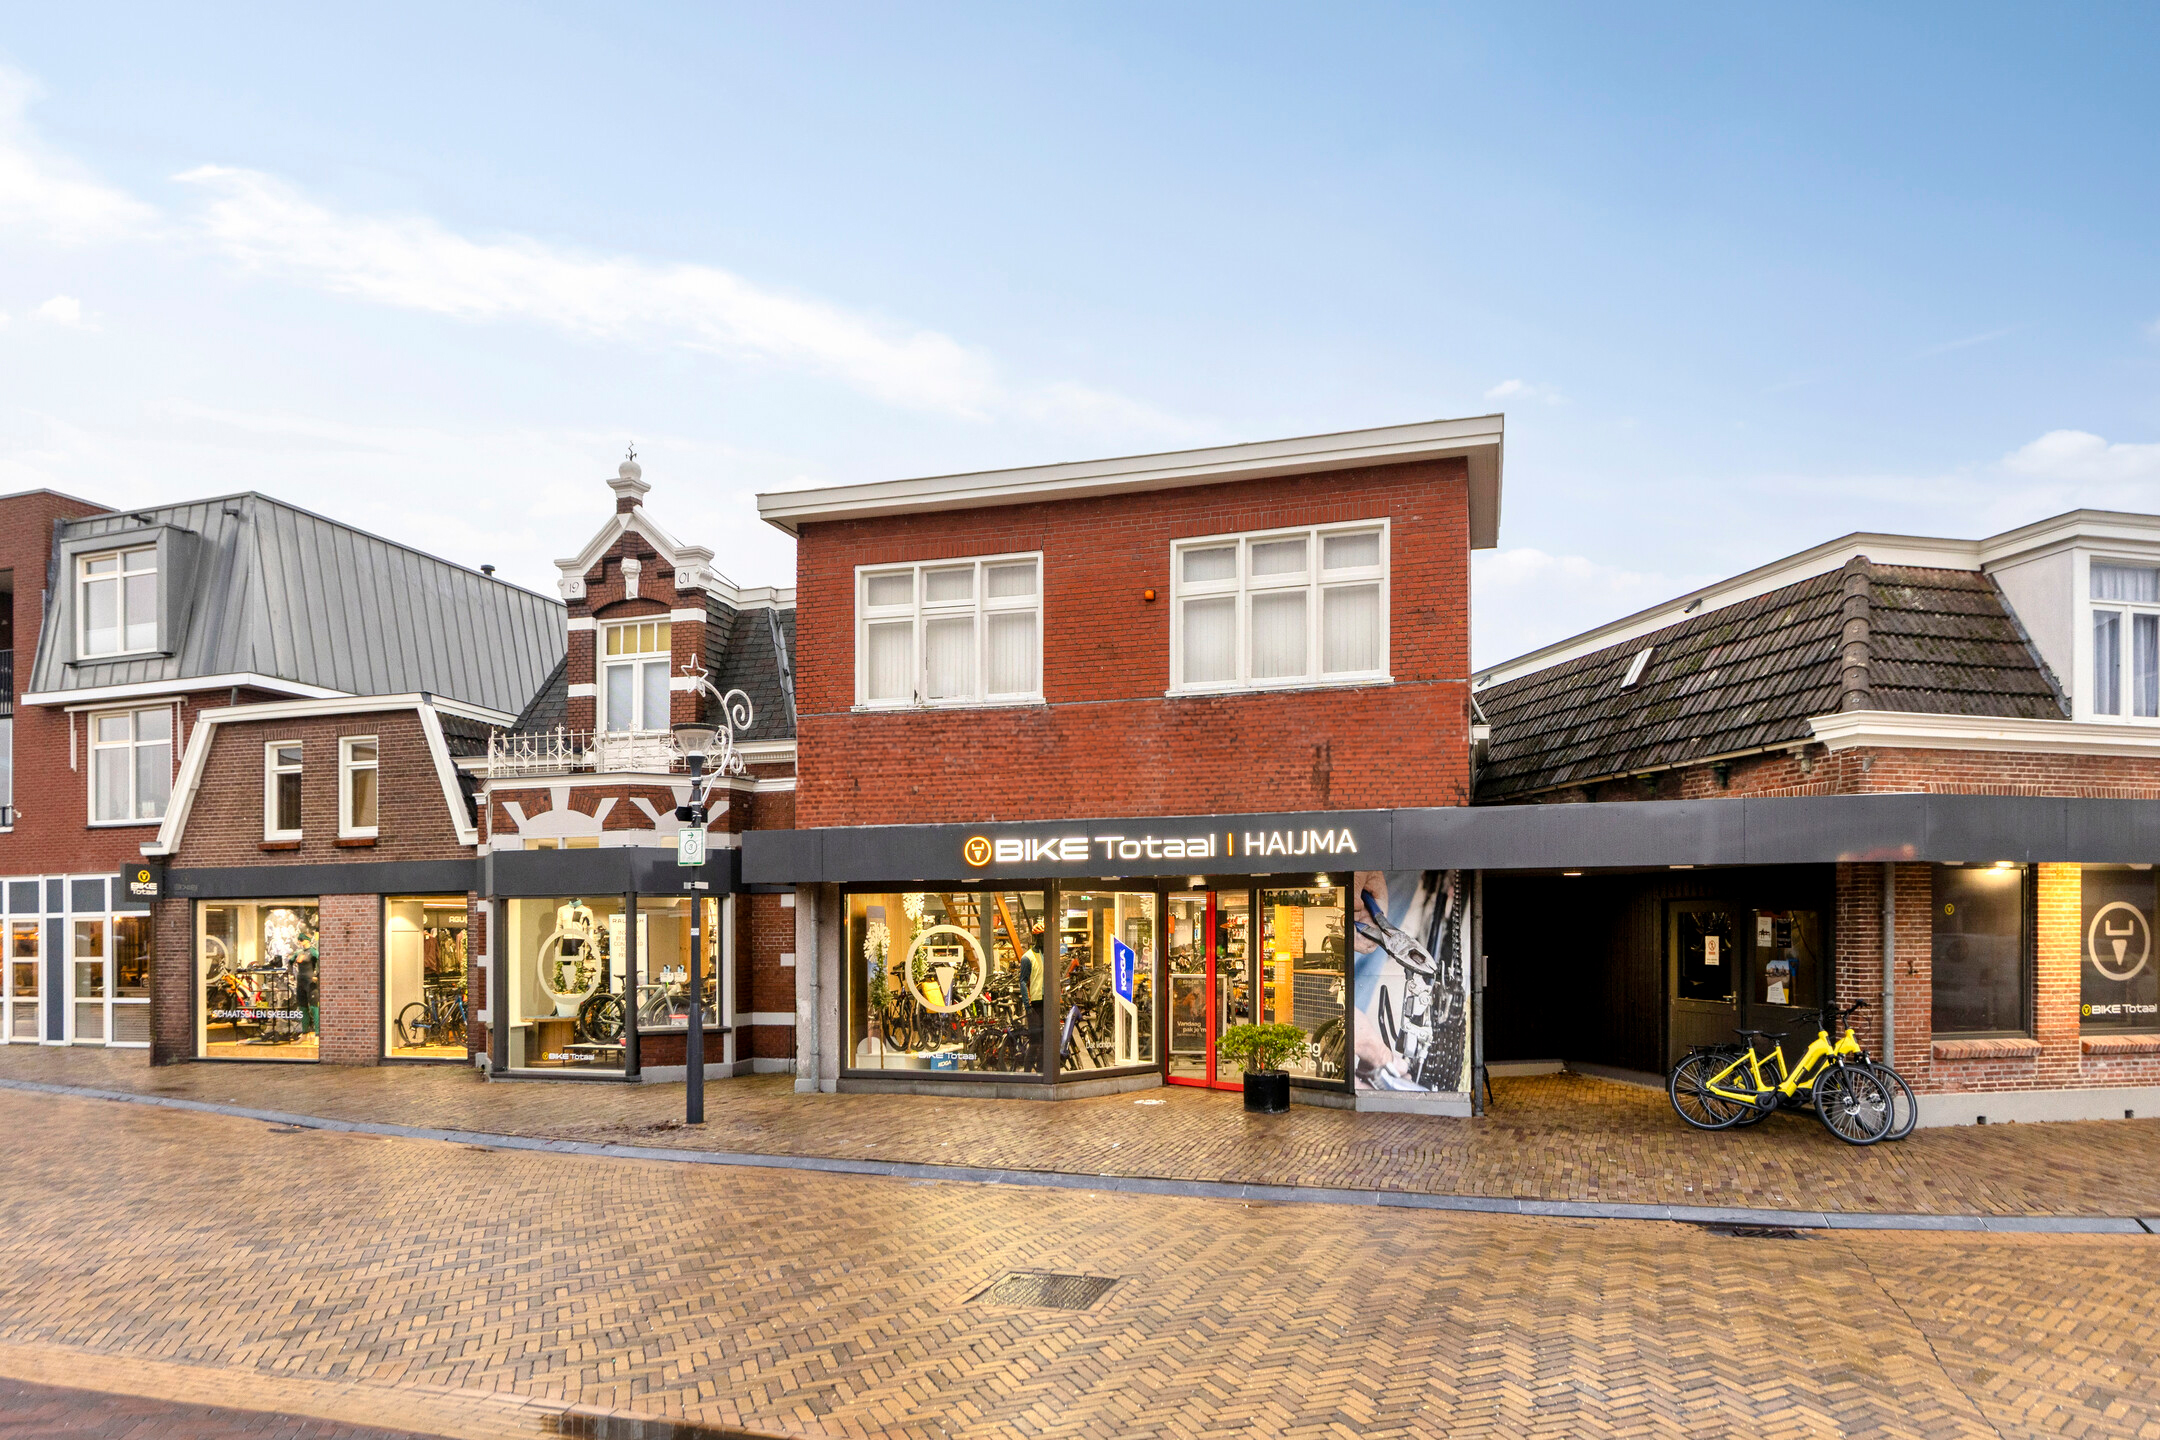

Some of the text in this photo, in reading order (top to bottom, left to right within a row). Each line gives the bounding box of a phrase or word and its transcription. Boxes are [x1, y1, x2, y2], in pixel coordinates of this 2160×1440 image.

[569, 582, 580, 593] 19
[995, 829, 1358, 862] BIKE Totaal HAIJMA
[130, 882, 157, 890] BIKE
[1119, 949, 1127, 991] KOGA
[212, 1010, 304, 1019] SCHAATSEN EN SKEELERS
[2091, 1003, 2158, 1015] BIKE Totaal
[548, 1052, 595, 1061] BIKE Totaal
[944, 1052, 977, 1060] Totaal
[1303, 1060, 1318, 1073] je
